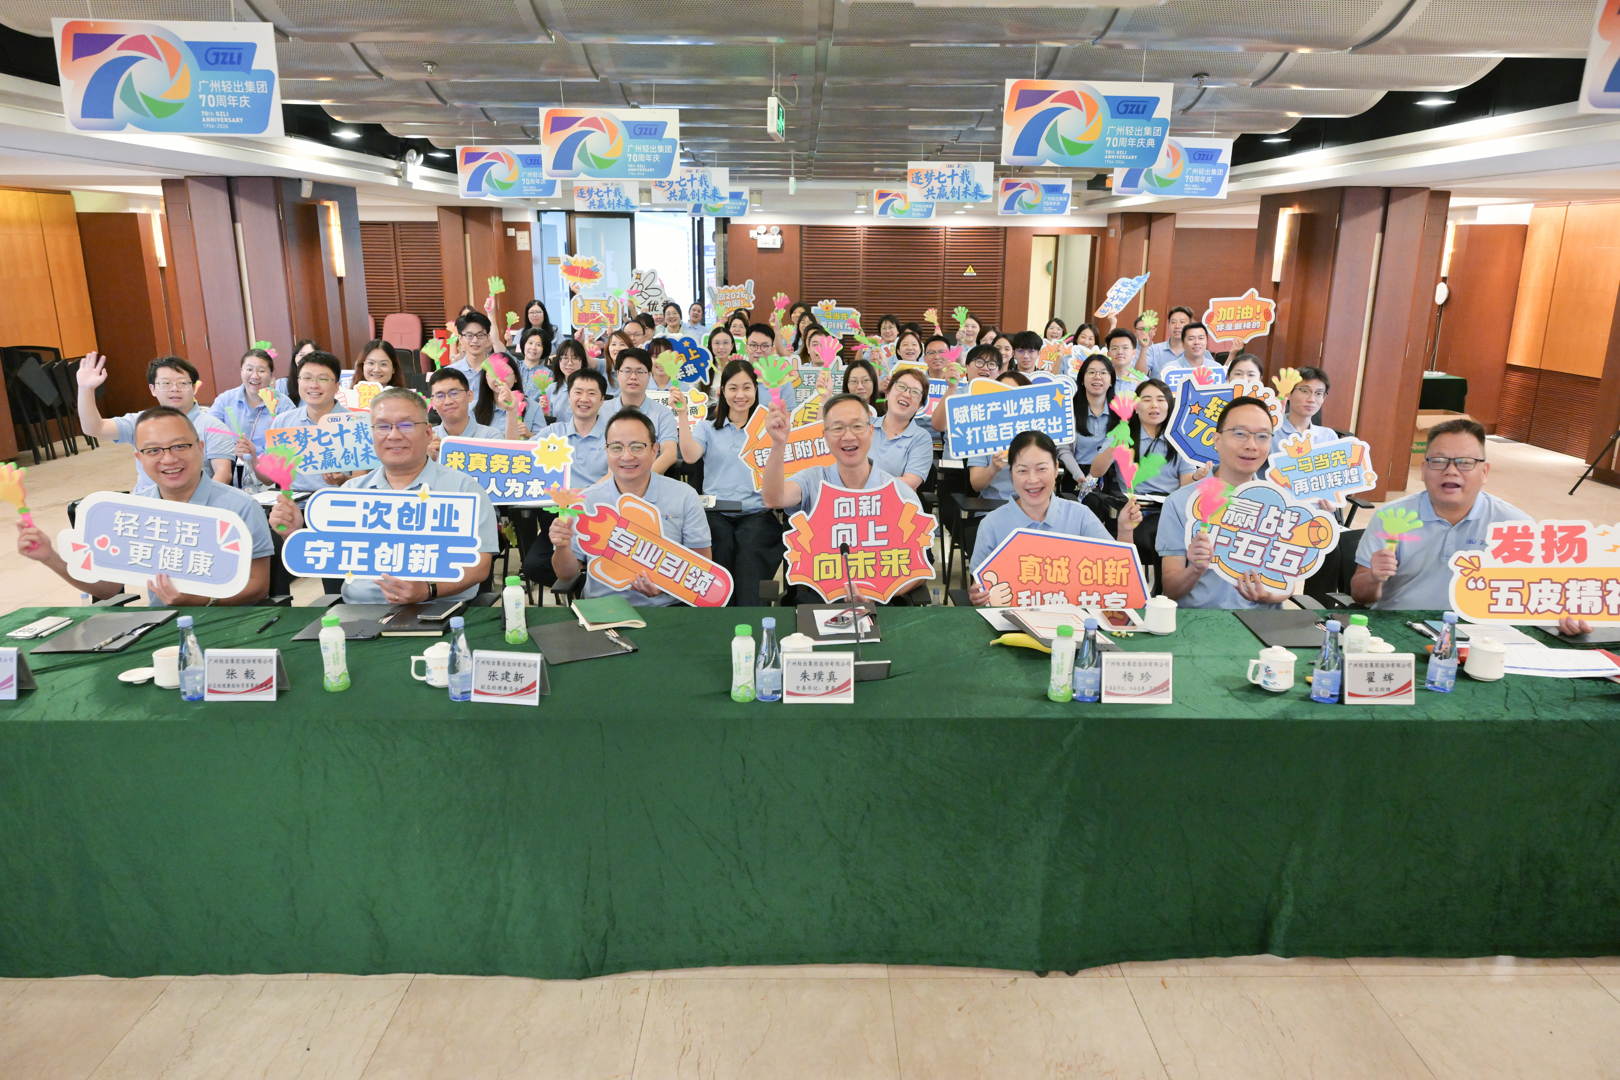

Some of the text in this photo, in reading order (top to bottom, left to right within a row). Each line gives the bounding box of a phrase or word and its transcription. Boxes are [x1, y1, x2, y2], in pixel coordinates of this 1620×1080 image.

[199, 80, 267, 93] 广州轻出集团
[199, 94, 251, 108] 70周年庆
[1106, 126, 1162, 136] 广州轻出集团
[1106, 137, 1155, 148] 70周年庆典
[627, 144, 672, 153] 广州轻出集团
[627, 154, 660, 162] 70周年庆
[911, 169, 972, 189] 逐梦七十载
[1186, 168, 1224, 176] 广州轻出集团
[576, 186, 622, 200] 逐梦七十载
[587, 197, 635, 210] 共赢创未来
[667, 188, 725, 202] 共赢创未来
[924, 184, 988, 200] 共赢创未来
[953, 394, 1051, 424] 赋能产业发展
[298, 444, 380, 472] 共赢创未
[445, 452, 532, 474] 求真务实
[1281, 450, 1348, 474] 一马当先
[476, 477, 546, 498] 人为本
[1293, 468, 1360, 496] 再创辉煌
[327, 500, 460, 532] 二次创业
[834, 494, 882, 518] 向新
[1222, 495, 1301, 540] 赢战
[114, 510, 200, 547] 轻生活
[831, 520, 889, 548] 向上
[1491, 524, 1588, 564] 发扬
[127, 541, 214, 577] 更健康
[304, 540, 440, 574] 守正创新
[608, 525, 716, 597] 专业引领
[813, 548, 911, 582] 向未来
[1018, 554, 1130, 586] 真诚 创新
[488, 670, 524, 683] 张建新
